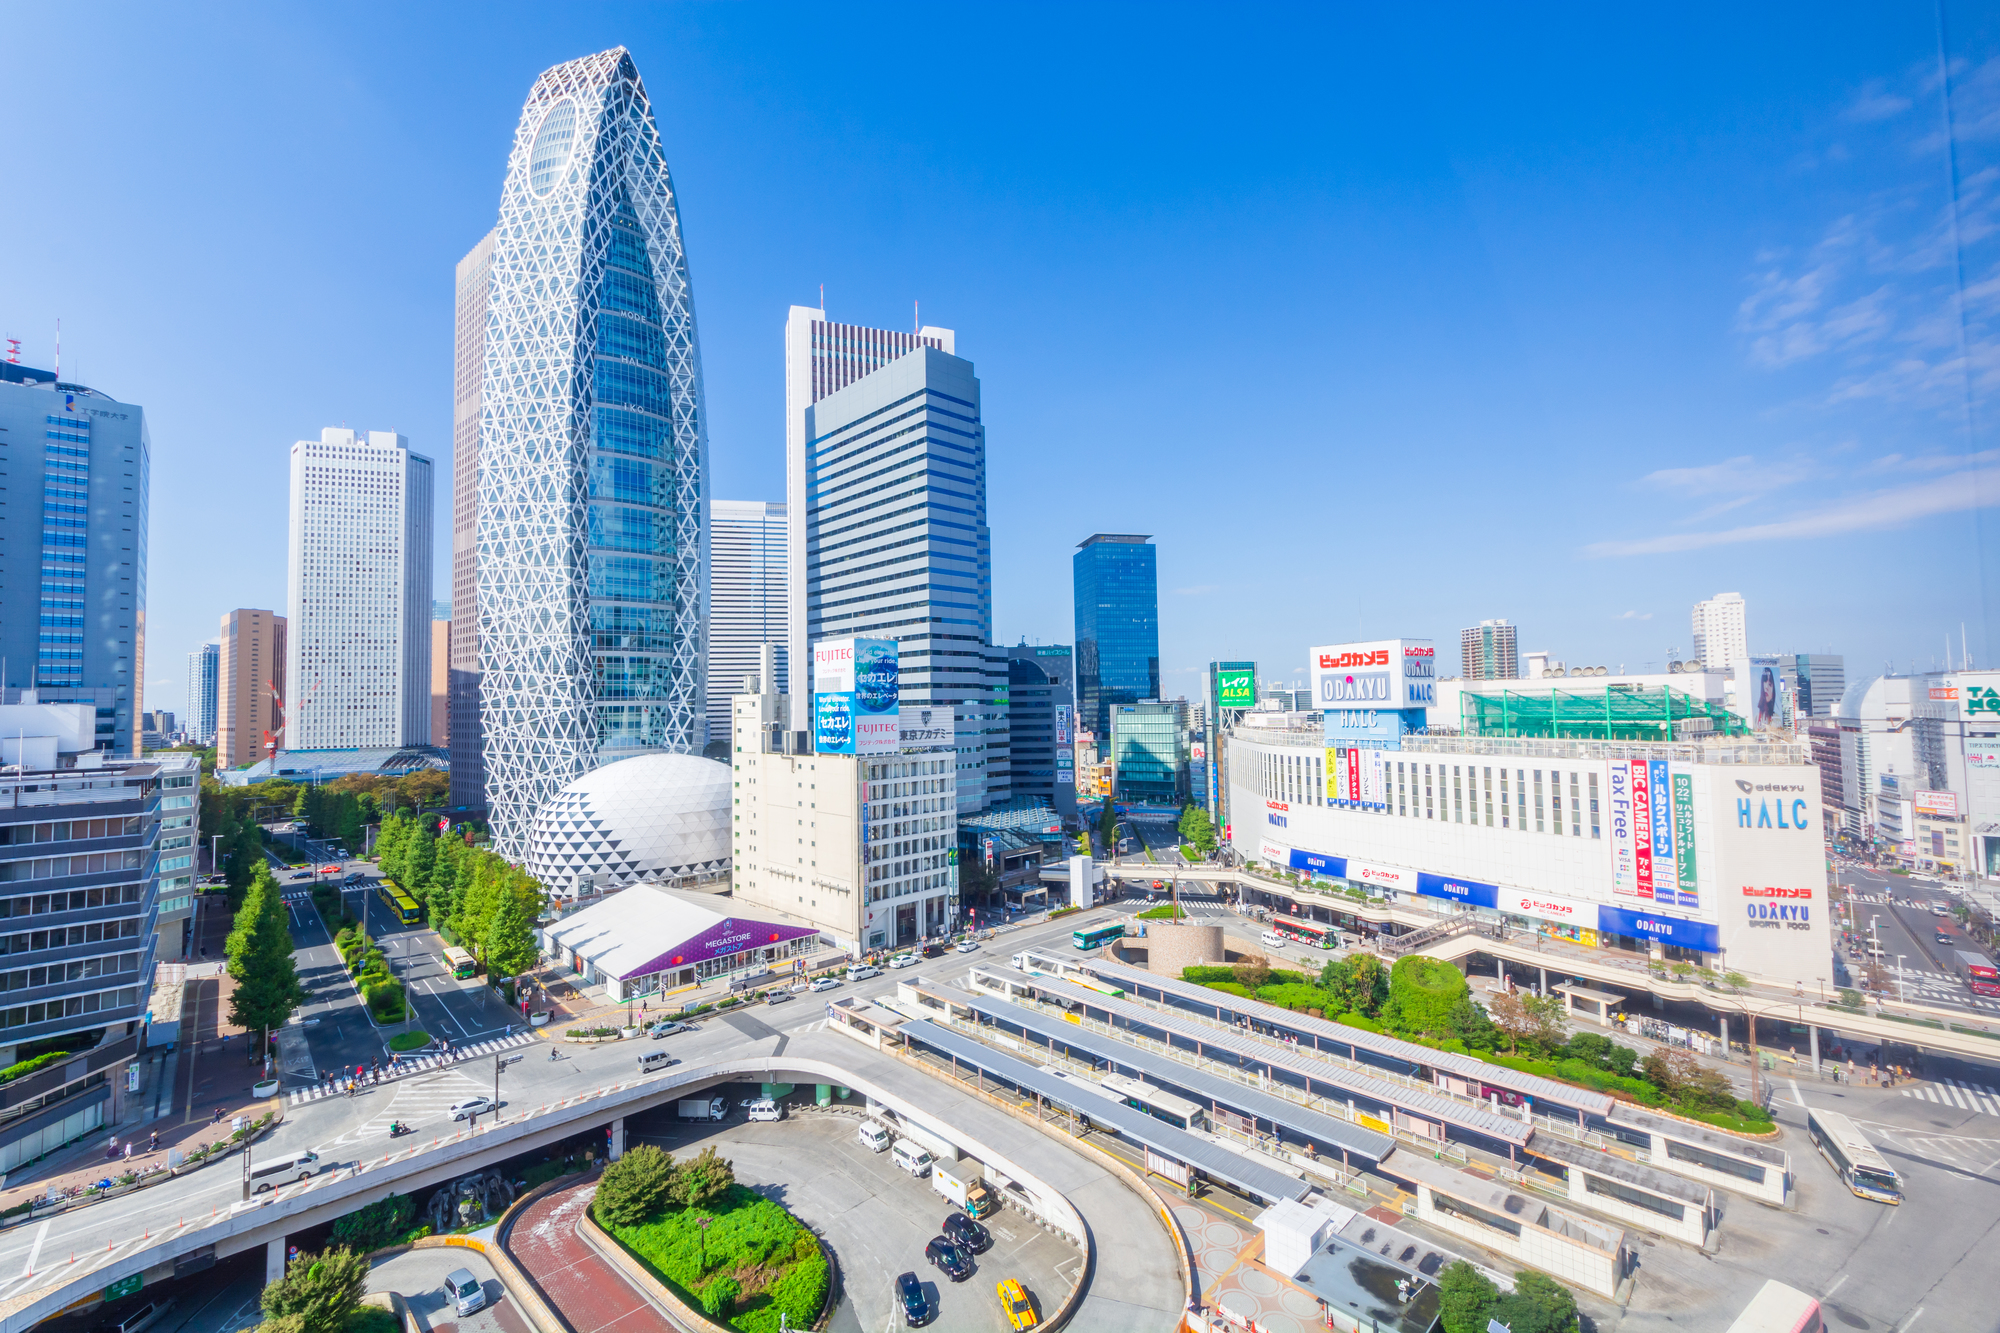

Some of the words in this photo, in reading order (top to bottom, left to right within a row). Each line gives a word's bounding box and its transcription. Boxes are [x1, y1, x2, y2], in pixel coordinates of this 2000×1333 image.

[816, 648, 853, 665] FUJITEC
[1319, 650, 1389, 668] ビックカメラ
[1404, 647, 1434, 657] ビックカメラ
[1405, 662, 1435, 677] ODAKYU
[1222, 677, 1249, 688] レイク
[1324, 676, 1387, 700] ODAKYU
[1222, 688, 1250, 698] ALSA
[1408, 682, 1433, 702] HALC
[1340, 709, 1378, 728] HALC
[857, 723, 898, 736] FUJITEC
[899, 728, 953, 741] 東京アカデミー
[858, 738, 896, 746] フジテック株式会社
[1612, 764, 1628, 795] Tax
[1632, 765, 1646, 788] BIC
[1266, 800, 1289, 811] ビックカメラ
[1736, 797, 1809, 829] HALC
[1268, 813, 1287, 828] ODAKYU
[1613, 800, 1629, 838] Free
[1634, 791, 1650, 850] CAMERA
[1653, 784, 1669, 854] ハルクスポーツ
[1684, 804, 1694, 849] ハルクフード
[1676, 803, 1688, 878] リニューアルオープン
[1307, 857, 1326, 867] ODAKYU
[1638, 857, 1649, 866] 7F
[1371, 870, 1399, 880] ビックカメラ
[1639, 869, 1649, 877] 2F
[1443, 883, 1469, 895] ODAKYU
[1742, 886, 1813, 899] ビックカメラ
[1533, 900, 1573, 913] ビックカメラ
[1747, 903, 1810, 921] ODAKYU
[1636, 920, 1673, 935] ODAKYU
[1748, 920, 1782, 930] SPORTS
[1786, 921, 1811, 931] FOOD
[705, 932, 752, 949] MEGASTORE
[714, 942, 744, 956] メガストア
